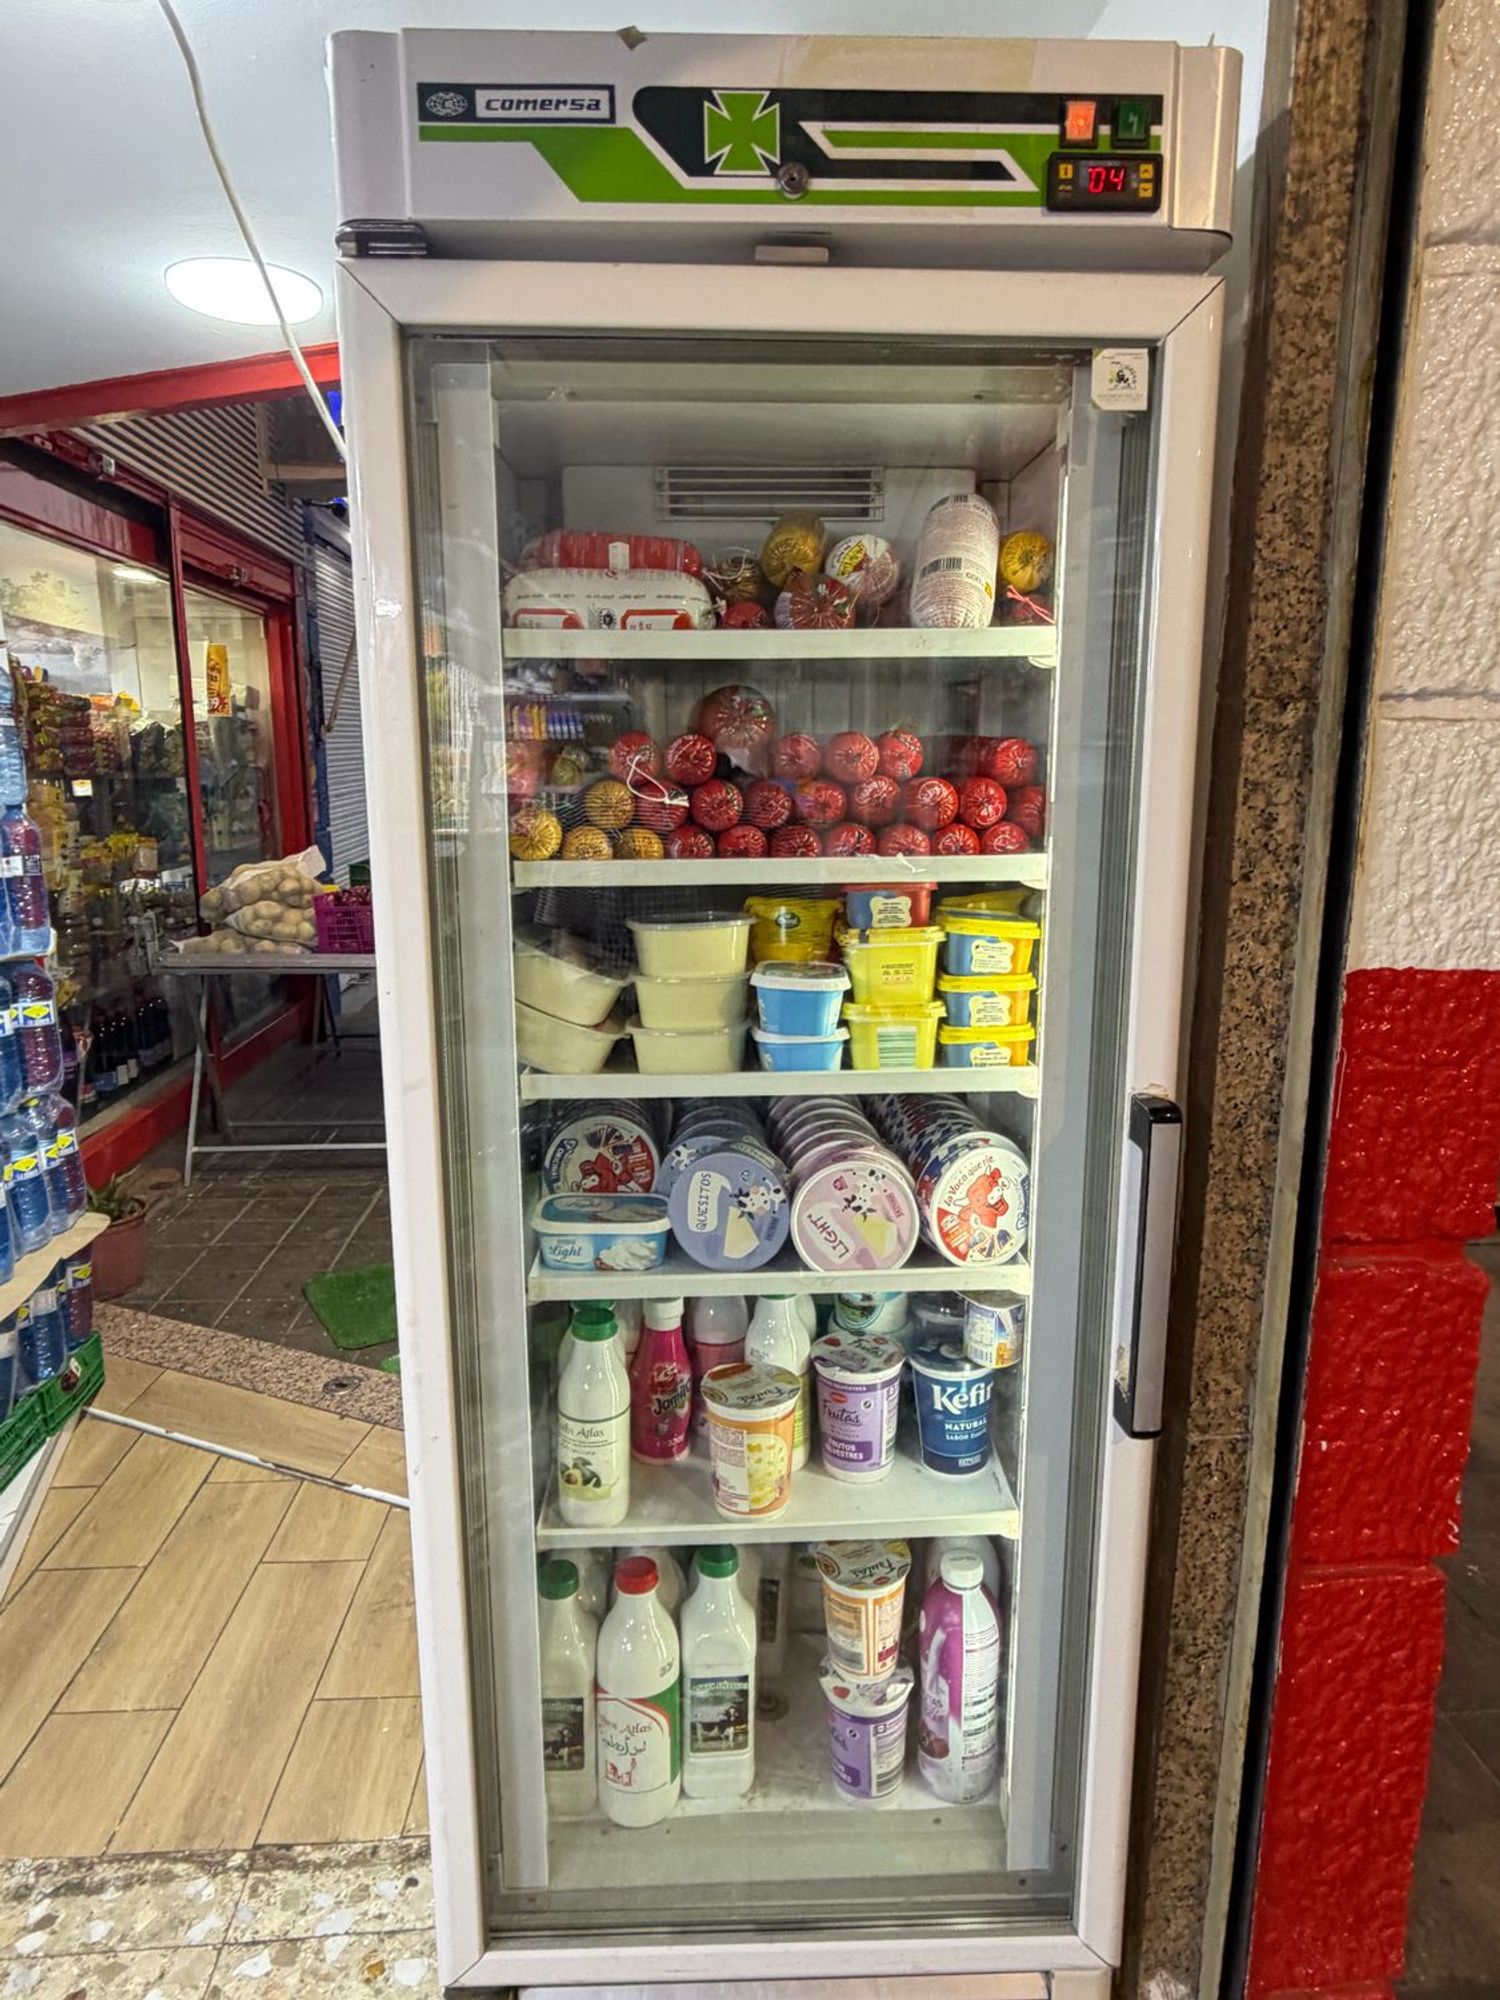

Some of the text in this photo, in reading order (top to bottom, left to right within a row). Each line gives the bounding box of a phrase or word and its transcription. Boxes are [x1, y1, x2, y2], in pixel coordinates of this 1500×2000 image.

[484, 98, 602, 112] comersa
[695, 1172, 712, 1231] QUESITOS
[930, 1381, 994, 1415] Kefir
